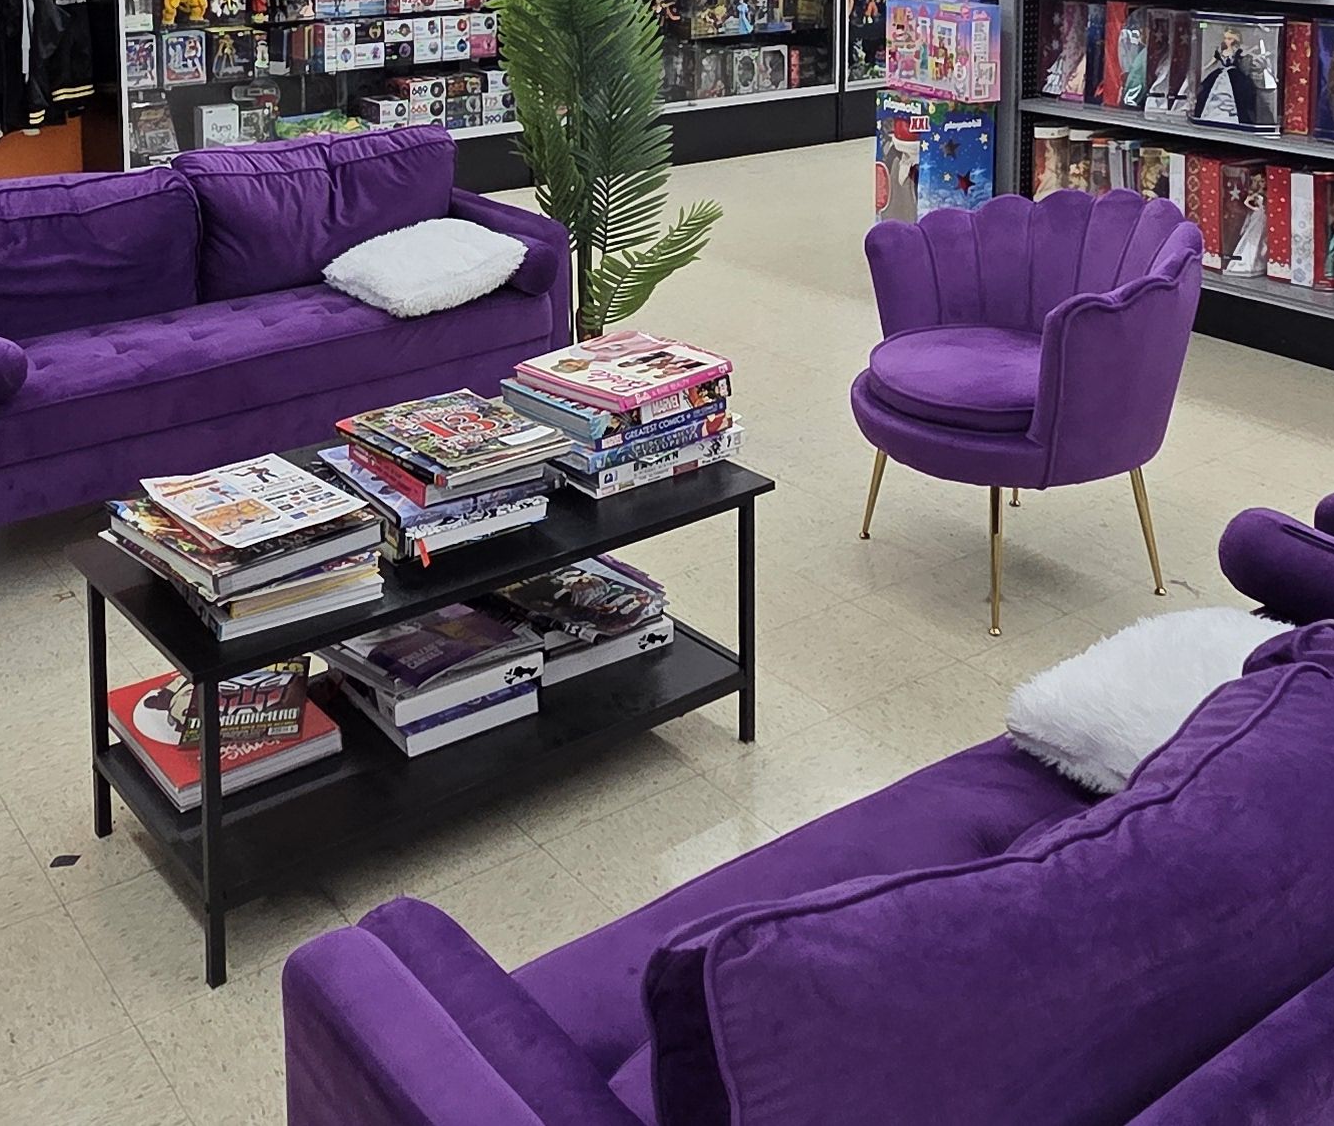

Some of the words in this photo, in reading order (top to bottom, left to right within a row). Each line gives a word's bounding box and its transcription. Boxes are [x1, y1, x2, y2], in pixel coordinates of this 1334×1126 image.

[883, 98, 922, 115] playmobil
[944, 118, 982, 132] playmobil
[652, 394, 680, 414] MARVEL
[624, 423, 657, 441] GREATEST
[658, 415, 686, 429] COMICS
